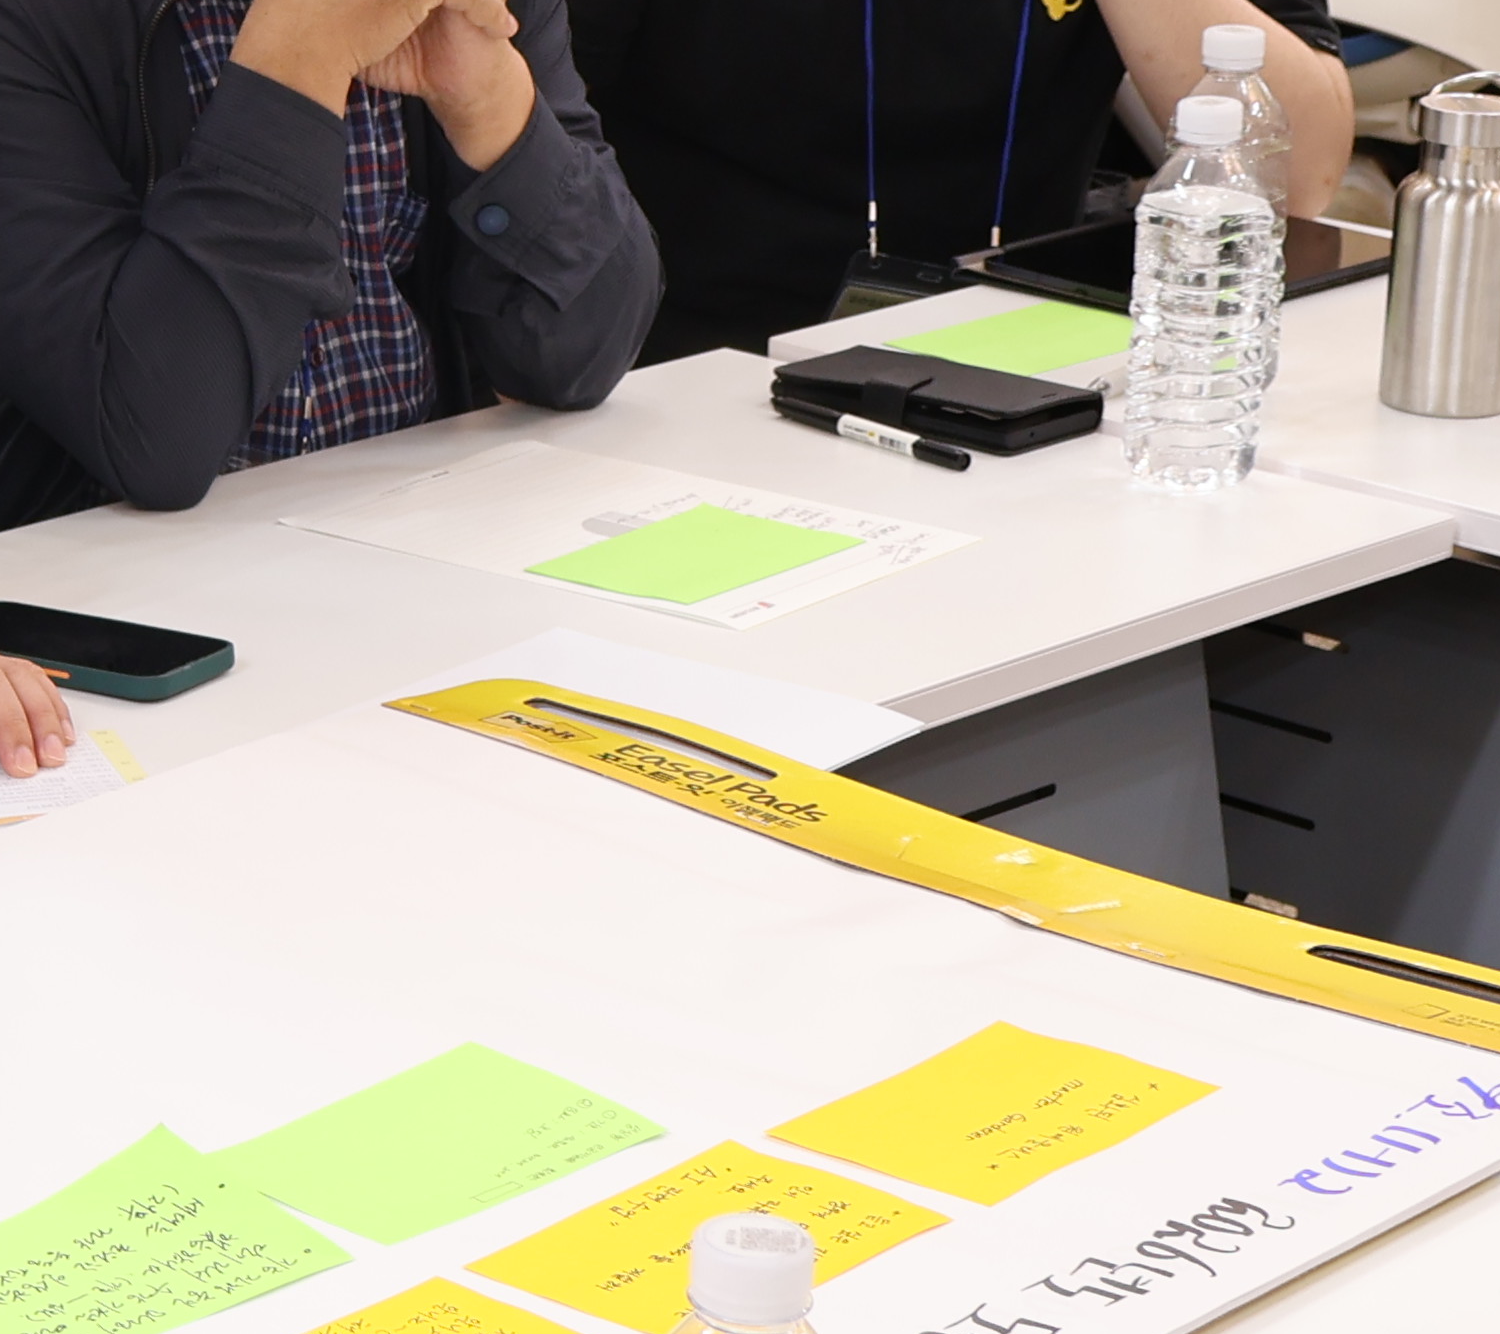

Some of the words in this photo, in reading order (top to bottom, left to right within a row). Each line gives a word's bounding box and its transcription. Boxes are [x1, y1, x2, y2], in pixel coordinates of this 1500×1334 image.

[614, 743, 723, 786] Easel
[725, 781, 829, 824] Pads
[966, 1114, 1027, 1141] Gardener
[1038, 1193, 1296, 1309] 2026년도
[262, 1257, 297, 1274] 지금
[127, 1282, 173, 1303] 수강
